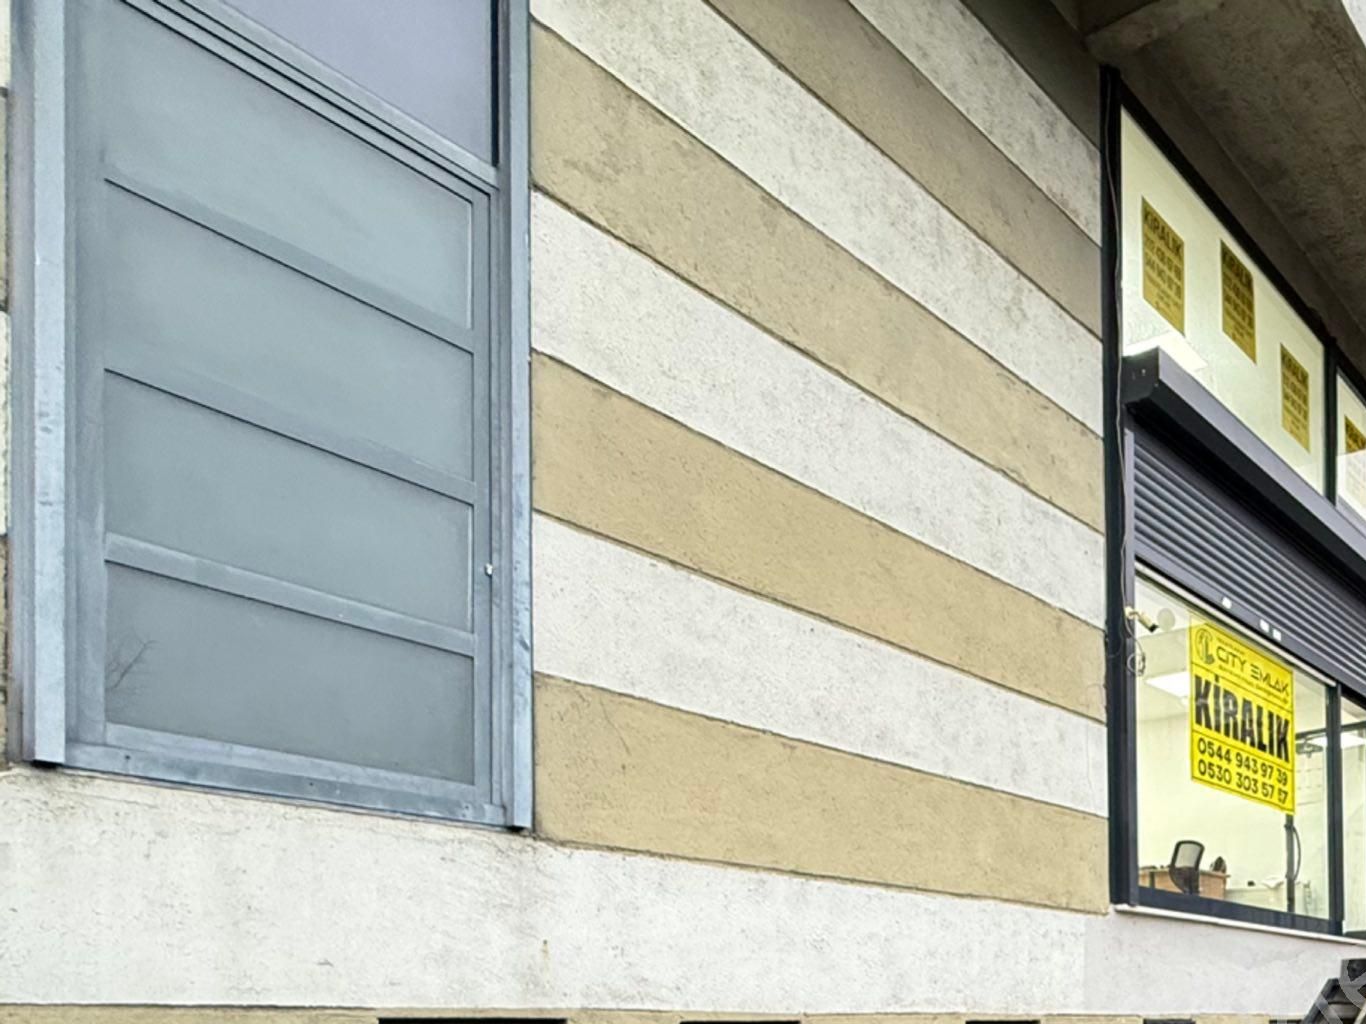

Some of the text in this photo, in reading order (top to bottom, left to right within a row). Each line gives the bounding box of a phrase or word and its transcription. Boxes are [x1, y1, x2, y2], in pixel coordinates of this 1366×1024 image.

[1216, 646, 1246, 672] CITY
[1251, 664, 1289, 696] EMLAK
[1197, 737, 1288, 787] 0544 943 97 39
[1197, 758, 1232, 785] 0530
[1235, 773, 1259, 794] 303
[1261, 782, 1275, 799] 57
